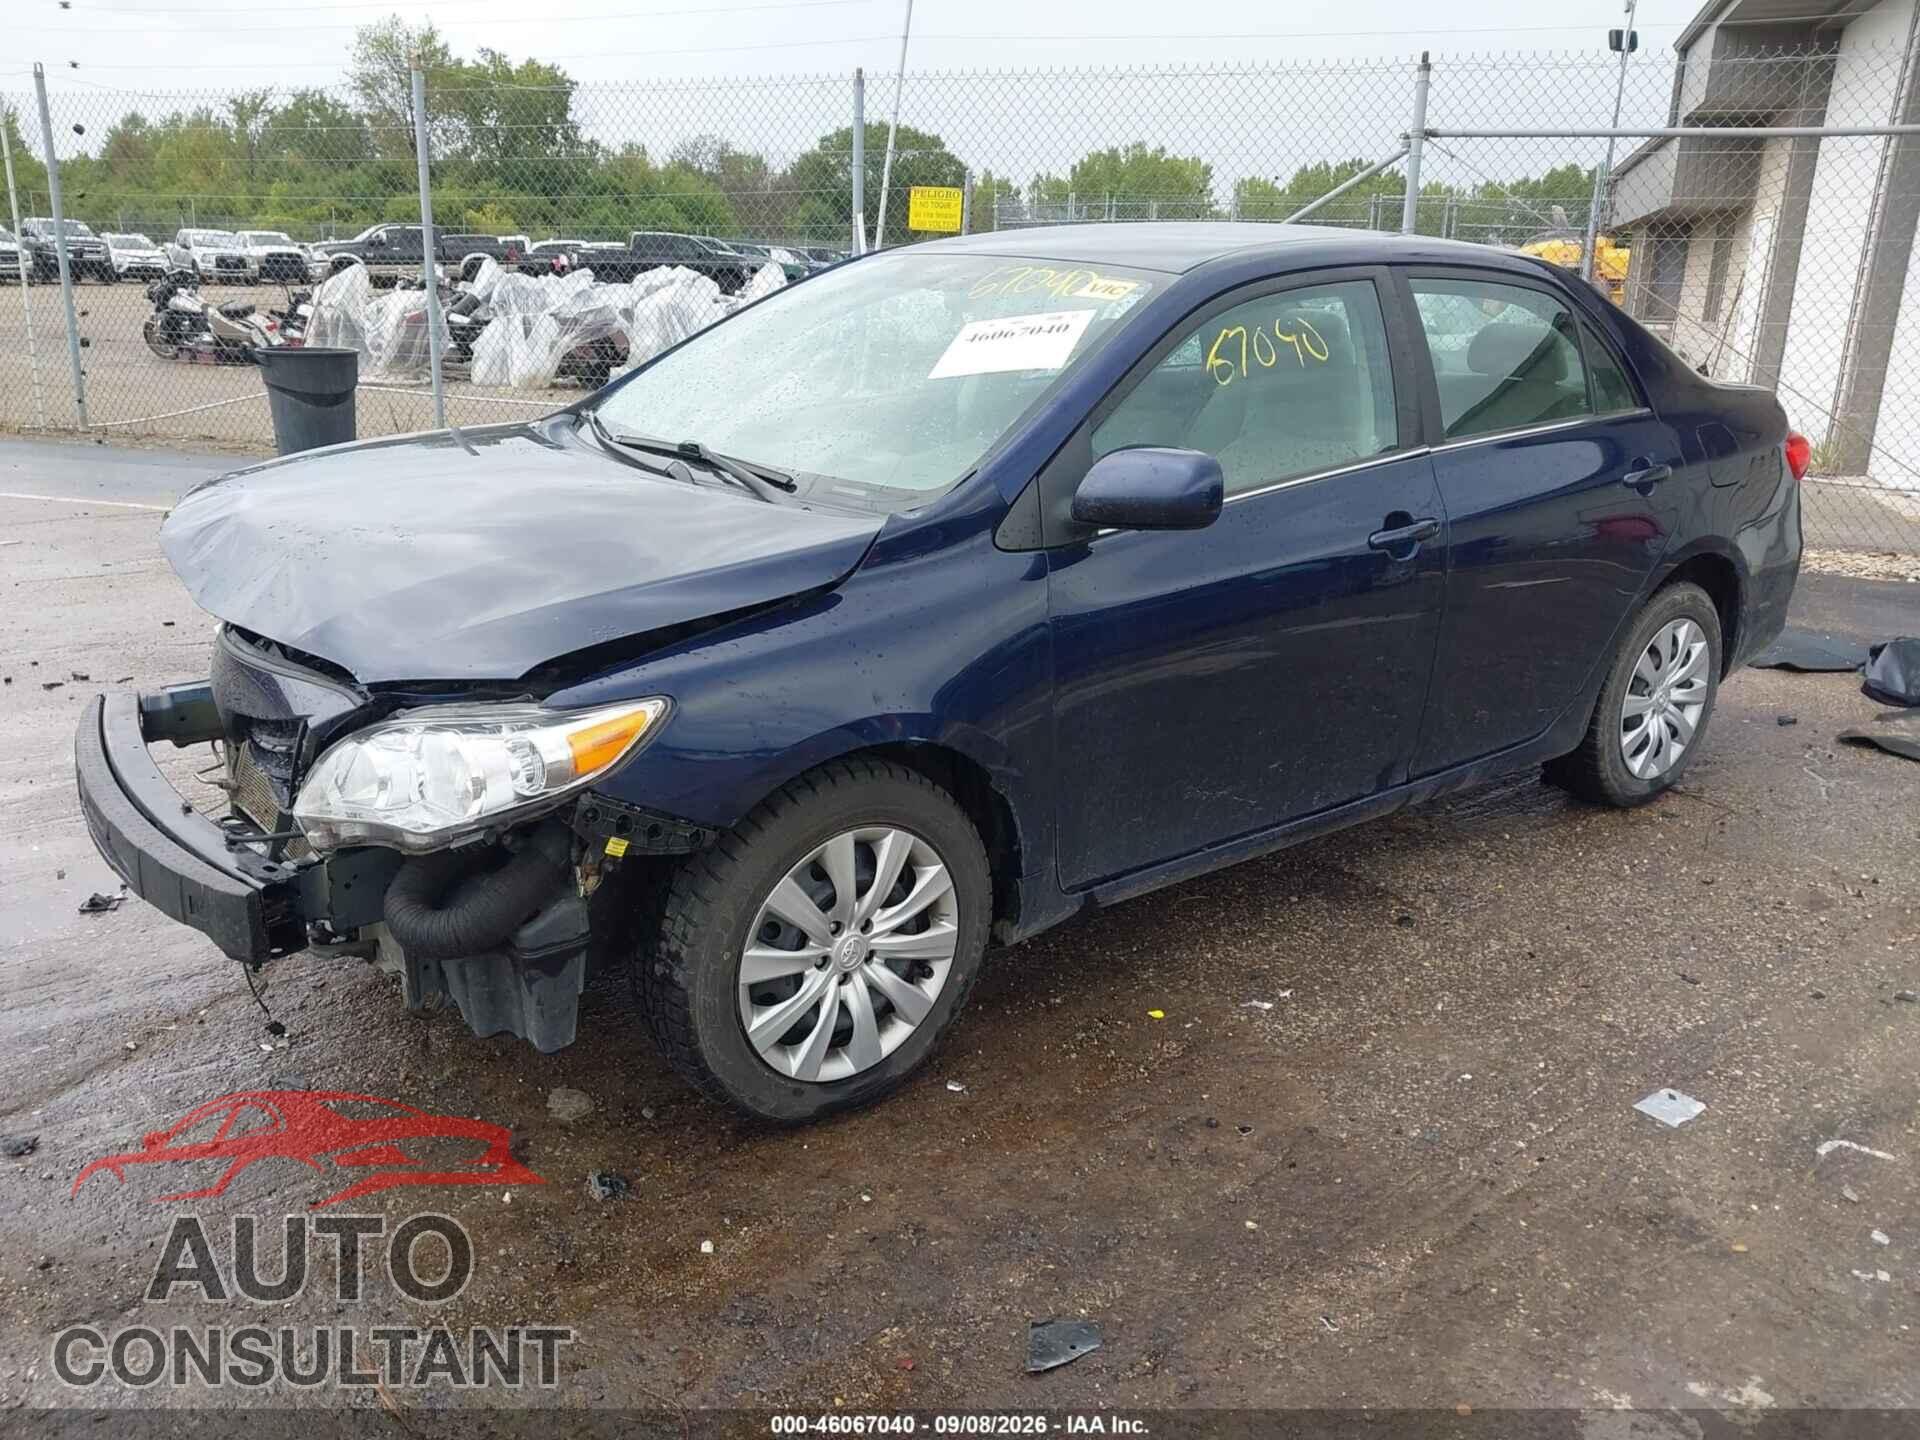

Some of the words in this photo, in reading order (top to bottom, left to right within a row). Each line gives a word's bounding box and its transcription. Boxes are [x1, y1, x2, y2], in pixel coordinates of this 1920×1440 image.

[912, 188, 961, 199] PELIGRO
[967, 265, 1098, 300] 67040
[1089, 281, 1129, 296] VIC
[965, 323, 1070, 344] 46067040
[1206, 316, 1329, 386] 67040
